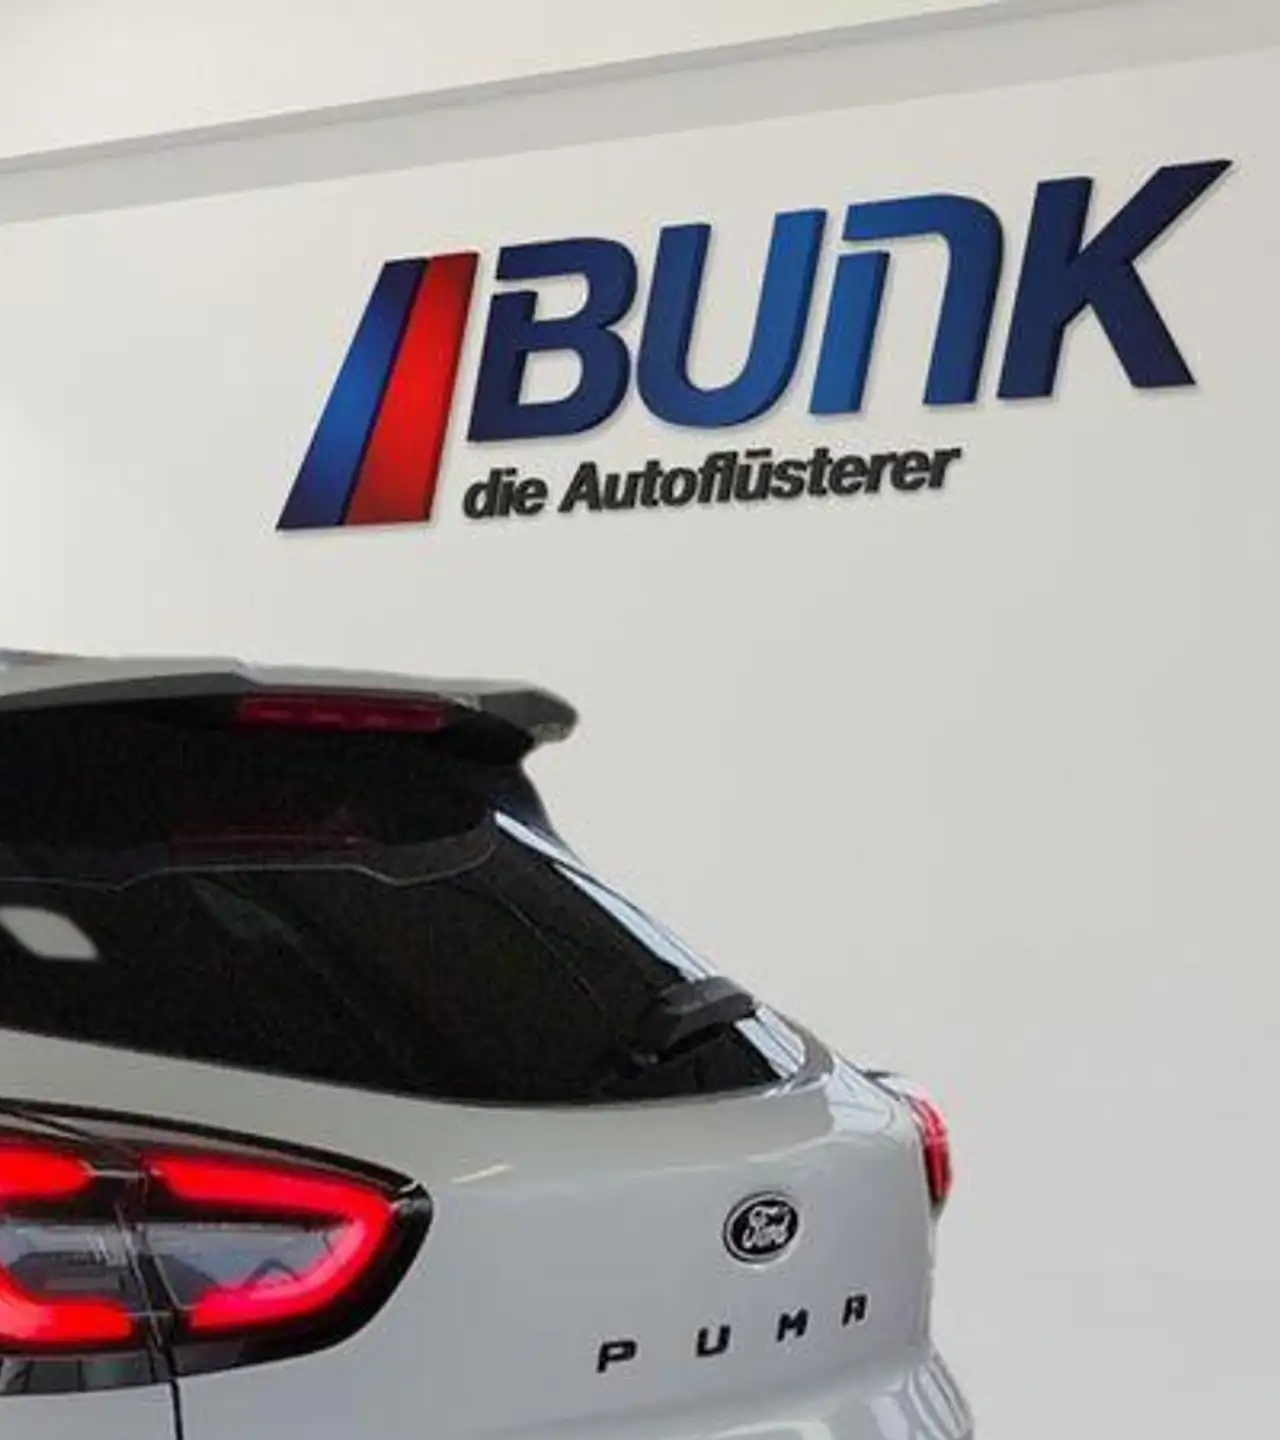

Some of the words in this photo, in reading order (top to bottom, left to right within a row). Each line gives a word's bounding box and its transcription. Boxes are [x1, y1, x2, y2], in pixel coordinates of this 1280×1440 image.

[466, 159, 1233, 442] BUNK
[462, 468, 546, 520] die
[557, 444, 963, 514] Autoflüsterer
[596, 1294, 868, 1374] PUMA
